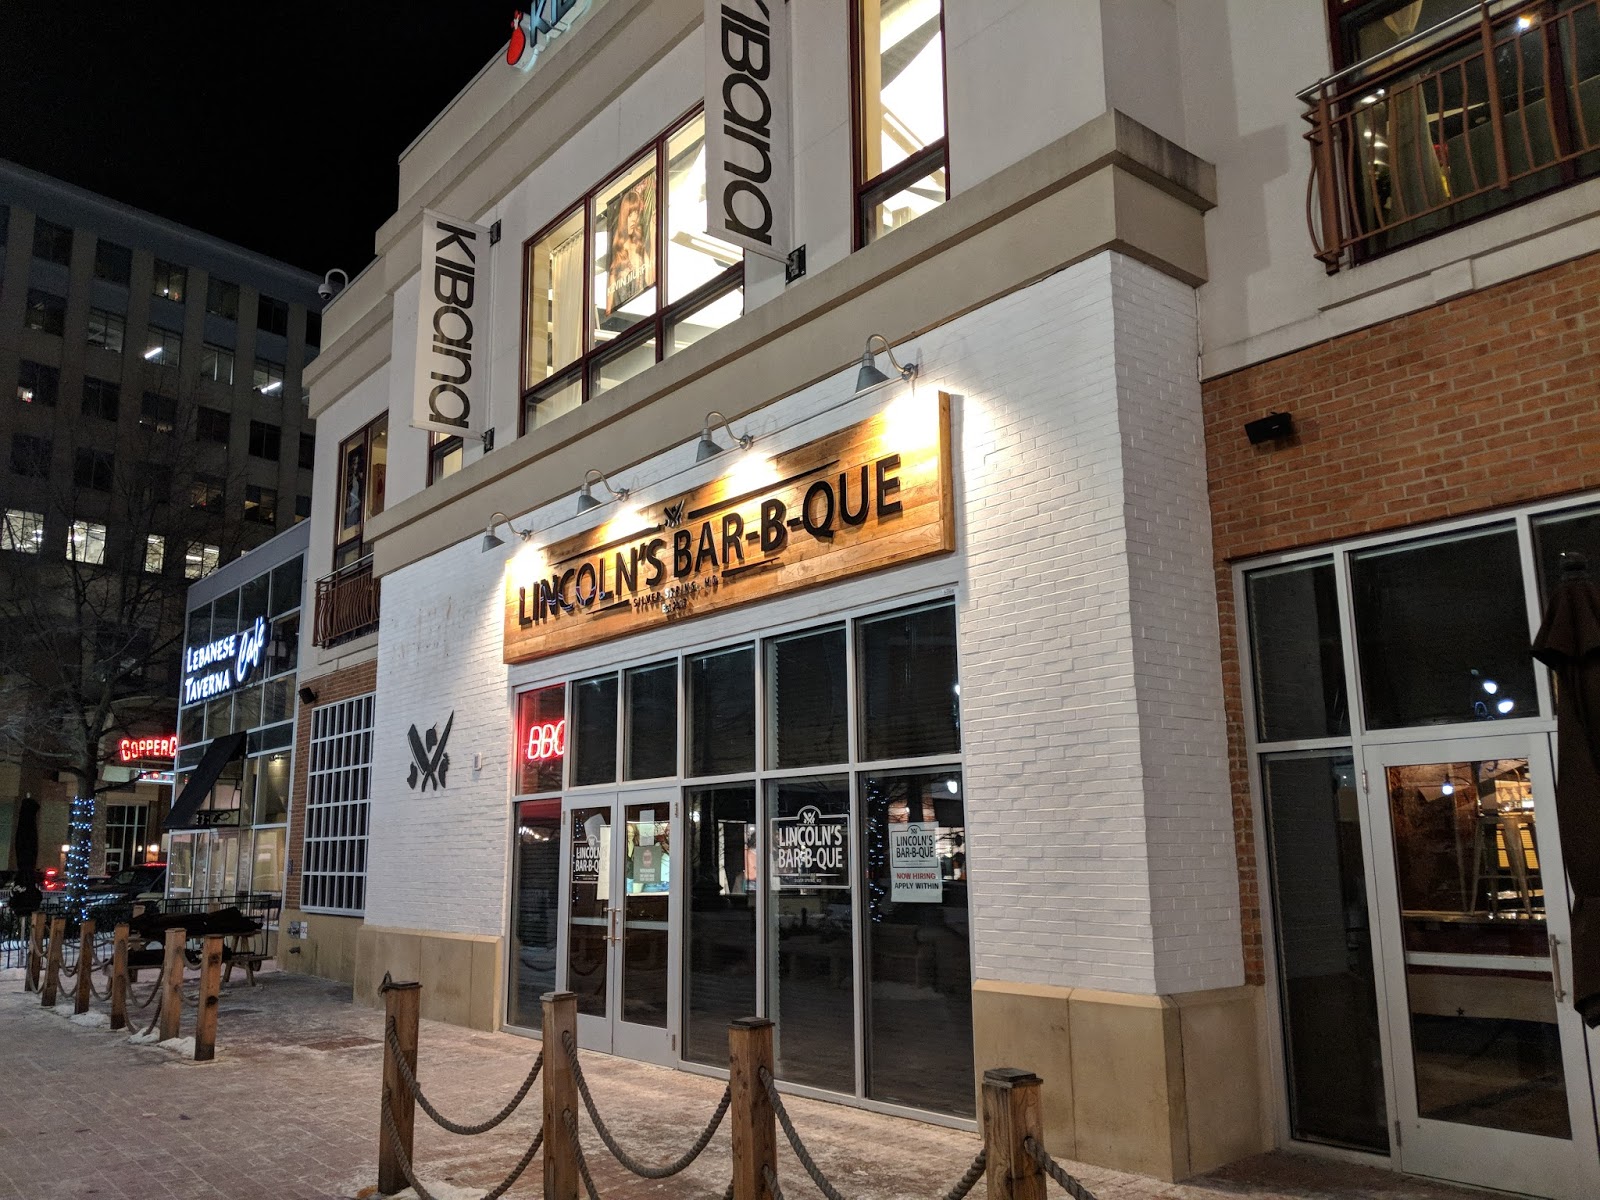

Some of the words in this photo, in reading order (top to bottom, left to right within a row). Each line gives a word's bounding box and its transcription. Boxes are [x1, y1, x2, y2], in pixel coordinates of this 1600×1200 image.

[721, 0, 773, 246] IBana
[518, 538, 667, 628] LINCOLN'S
[673, 453, 904, 578] BAR-B-QUE
[186, 634, 236, 674] LEBANESE
[184, 668, 231, 704] TAVERNA
[778, 824, 843, 847] LINCOLN'S
[896, 834, 934, 847] LINCOLN'S
[575, 845, 601, 860] LINCOLN
[778, 847, 843, 871] BAR-B-QUE
[896, 846, 934, 859] BAR-B-QUE
[575, 858, 600, 873] BAR-B-Q
[896, 872, 912, 880] NOW
[912, 872, 937, 880] HIRING
[894, 882, 914, 890] APPLY
[915, 882, 940, 890] WITHIN
